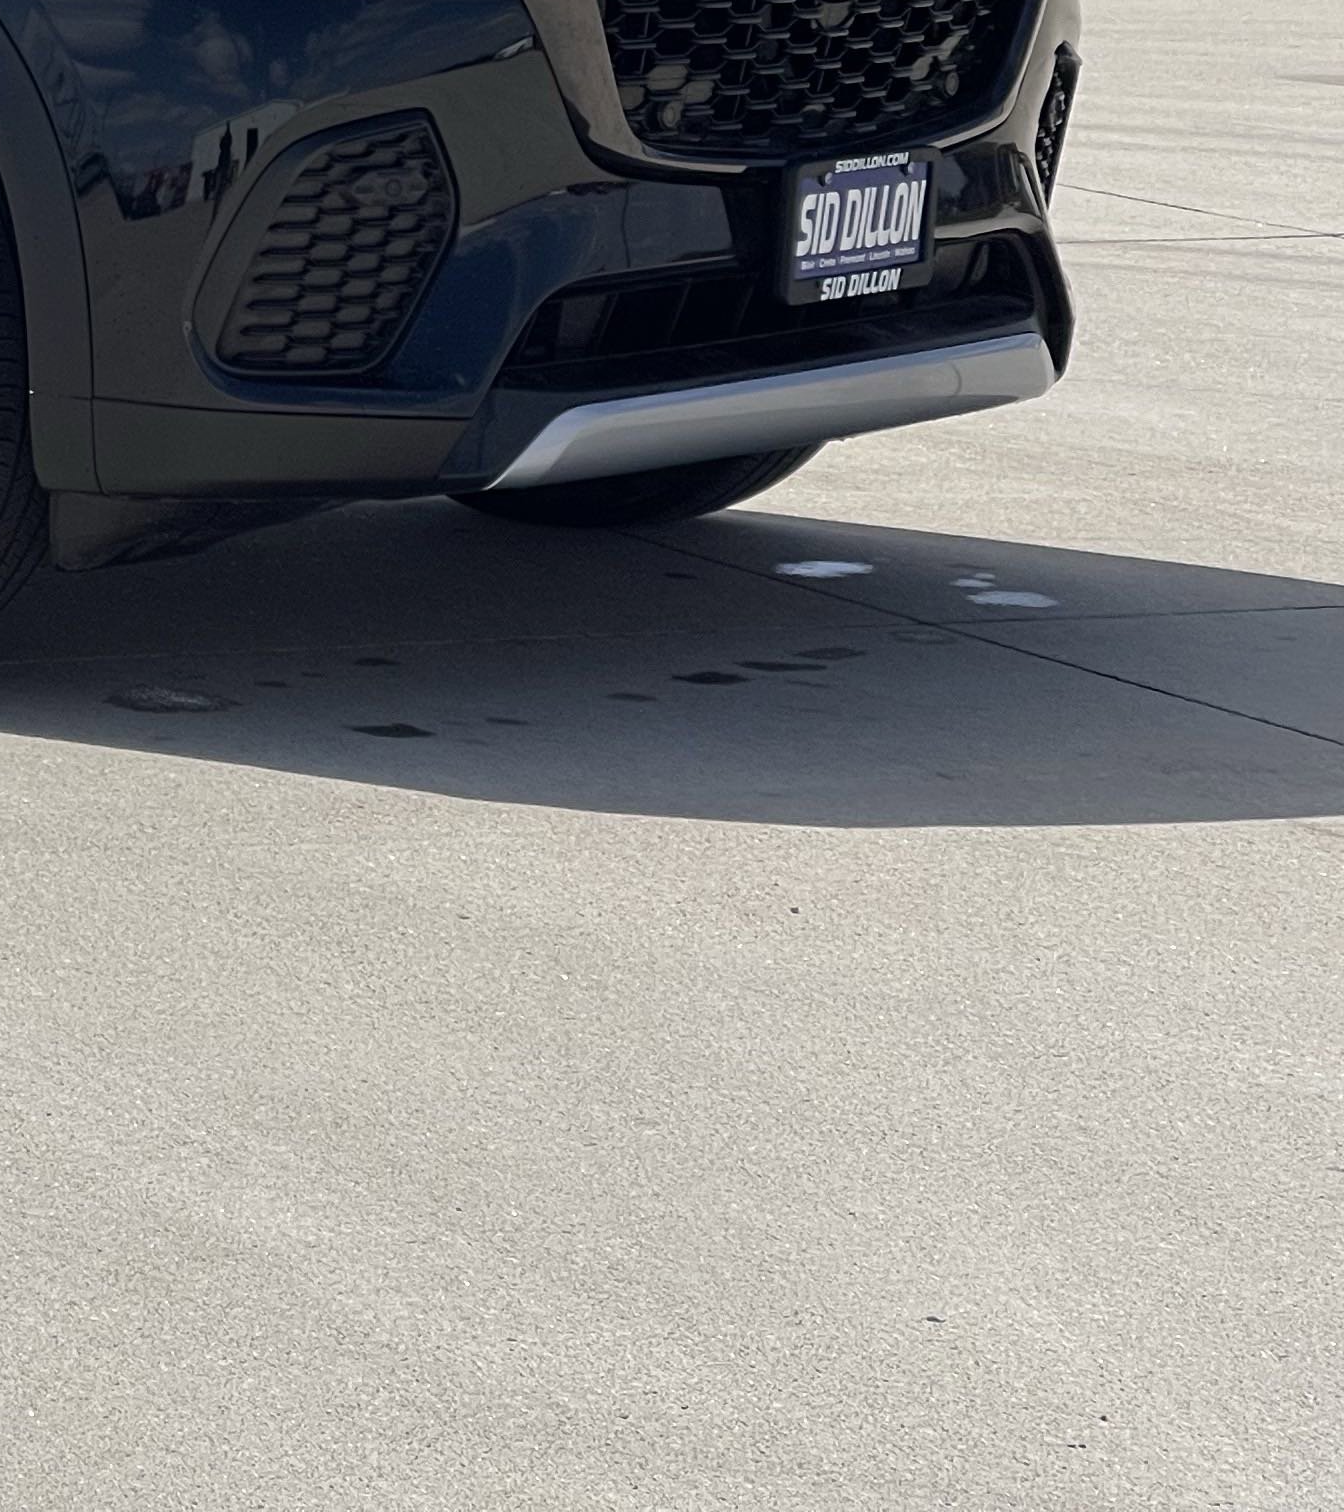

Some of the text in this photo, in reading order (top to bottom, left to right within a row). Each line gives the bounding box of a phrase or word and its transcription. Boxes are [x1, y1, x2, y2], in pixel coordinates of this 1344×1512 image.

[834, 151, 910, 173] SIDDILLON.COM
[796, 179, 927, 257] SID DILLON
[820, 268, 902, 301] SID DILLON
